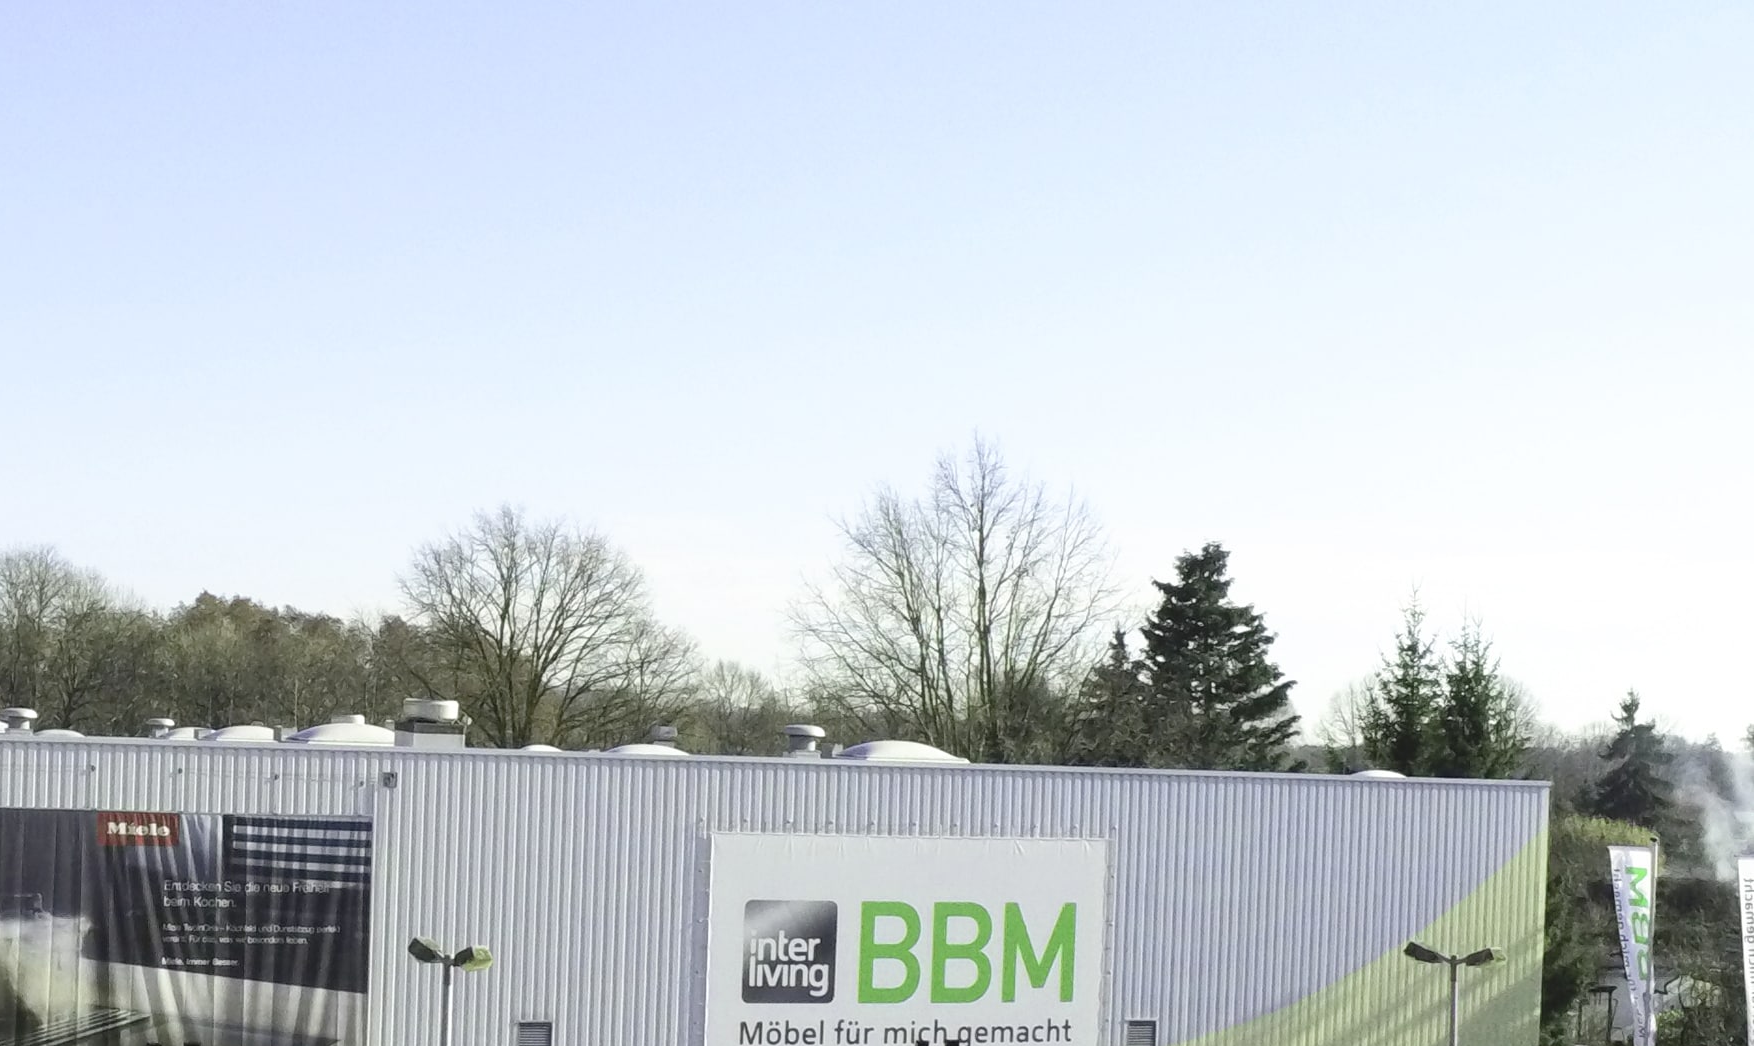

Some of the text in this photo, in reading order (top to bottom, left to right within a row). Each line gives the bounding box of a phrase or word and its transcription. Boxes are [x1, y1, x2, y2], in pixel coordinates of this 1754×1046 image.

[106, 821, 171, 838] Miele
[164, 880, 222, 892] Entdecken
[224, 881, 241, 892] Sie
[245, 881, 260, 892] die
[263, 883, 290, 893] neue
[163, 896, 237, 908] beim Kochen.
[750, 930, 821, 962] inter
[858, 901, 1077, 1004] BBM
[748, 959, 829, 997] living
[739, 1020, 824, 1046] Möbel
[834, 1020, 874, 1045] für
[883, 1020, 947, 1045] mich
